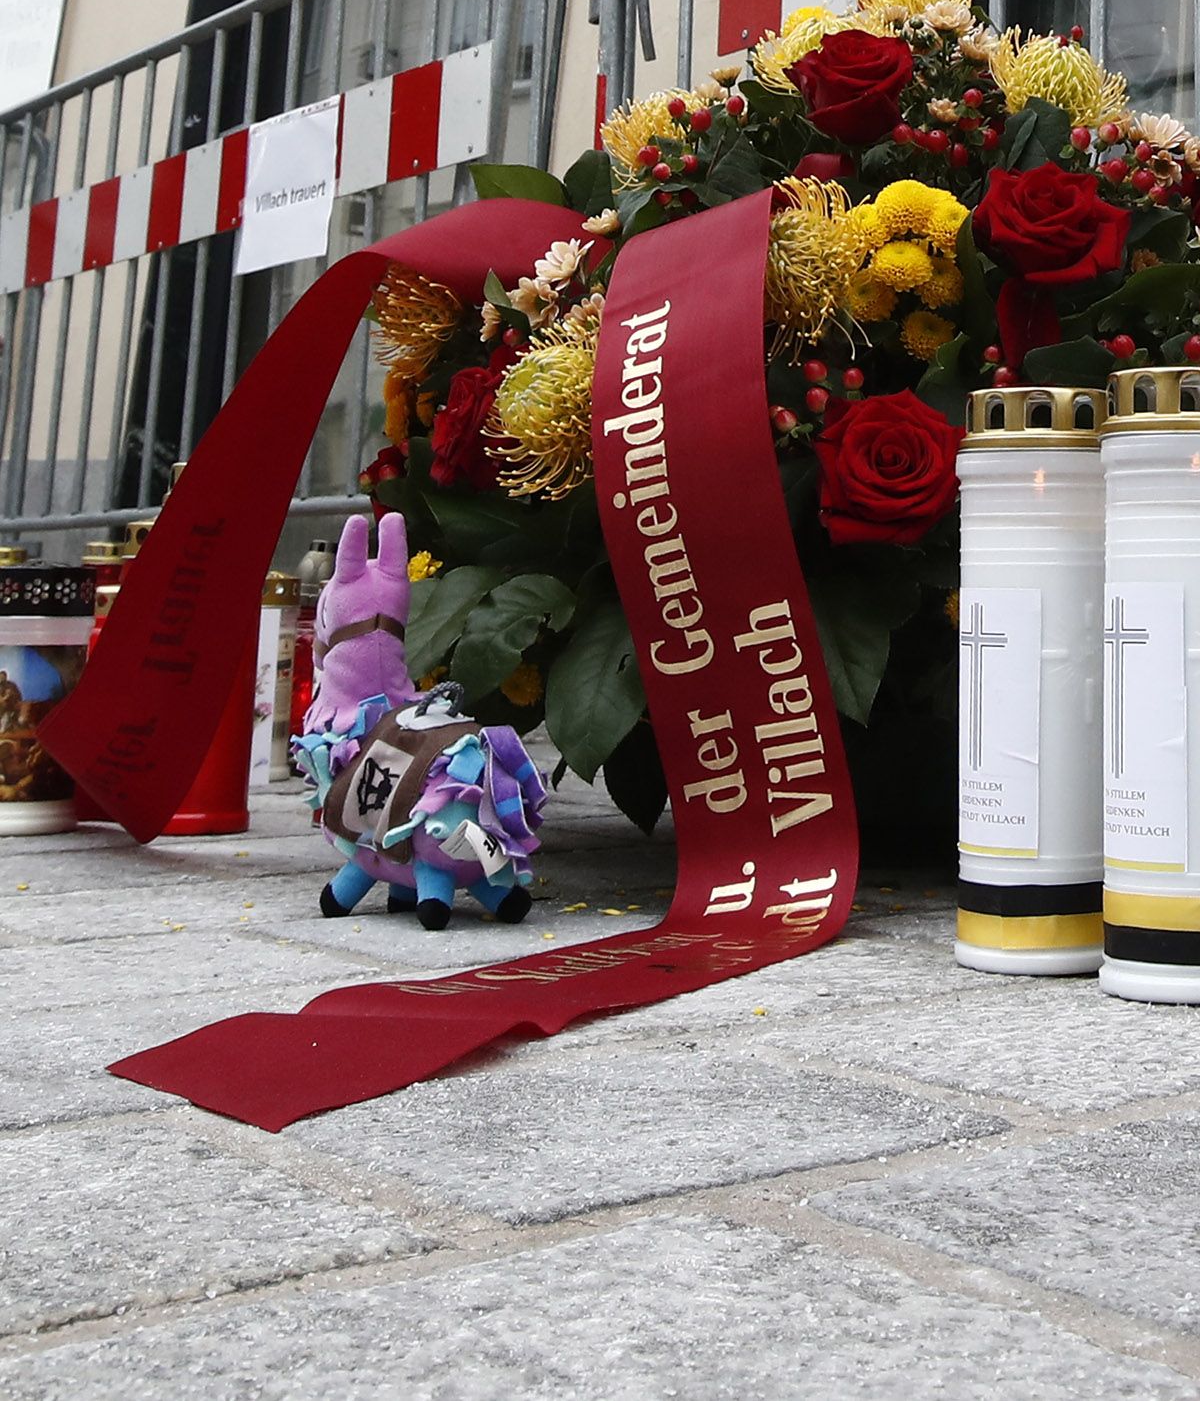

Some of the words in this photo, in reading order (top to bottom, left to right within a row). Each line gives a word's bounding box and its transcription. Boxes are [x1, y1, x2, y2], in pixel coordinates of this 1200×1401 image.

[255, 187, 288, 213] Villach
[290, 179, 327, 205] trauert
[603, 300, 715, 676] Gemeinderat
[733, 599, 834, 838] Villach
[682, 708, 748, 813] der
[980, 812, 1026, 825] VILLACH
[1124, 825, 1170, 837] VILLACH
[702, 861, 756, 917] u.
